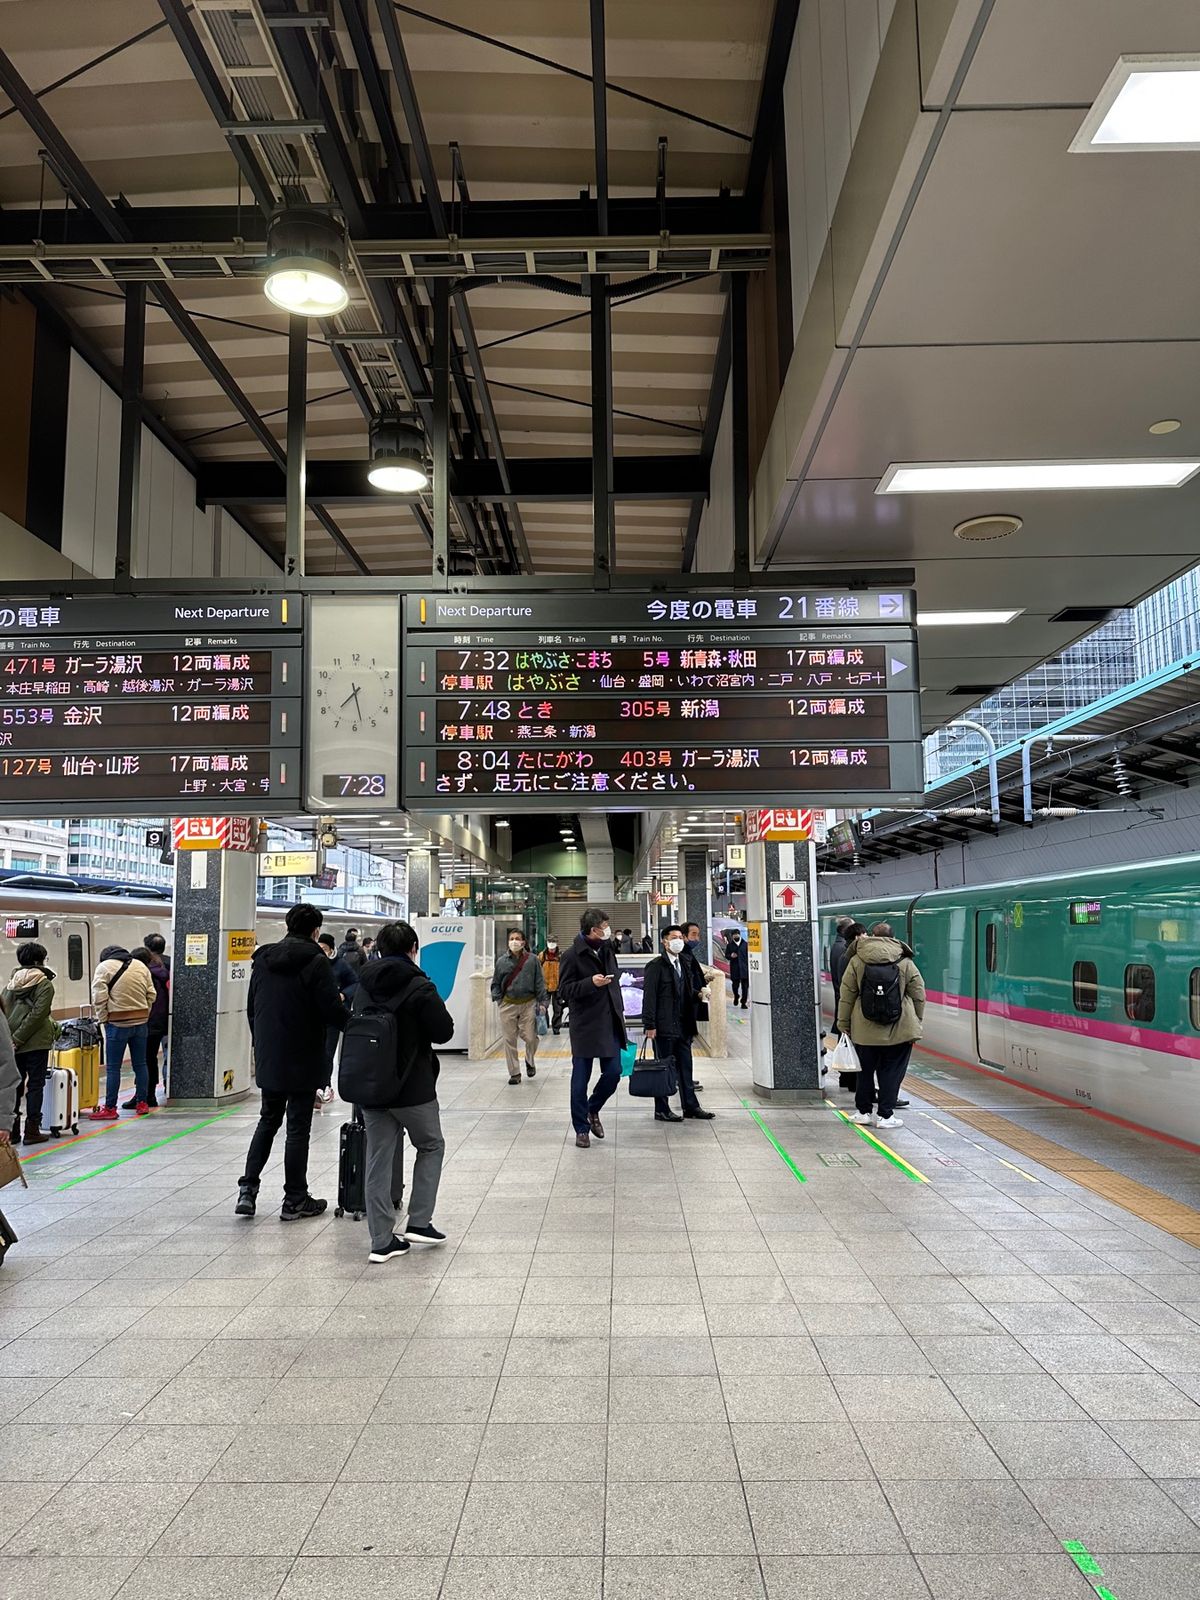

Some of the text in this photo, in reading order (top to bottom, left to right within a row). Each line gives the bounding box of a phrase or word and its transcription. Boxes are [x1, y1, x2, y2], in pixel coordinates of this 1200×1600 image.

[175, 607, 270, 620] Next Departure
[438, 605, 532, 619] Next Departure
[647, 596, 860, 620] 今度の電車 21番線
[0, 606, 61, 628] の電車
[73, 640, 90, 648] 行先
[185, 638, 202, 646] 記事
[453, 635, 471, 644] 時刻
[538, 635, 562, 644] 列車名
[610, 635, 627, 643] 番号
[687, 634, 704, 643] 行先
[710, 634, 750, 642] Destination
[800, 633, 816, 641] 記事
[333, 658, 341, 666] 11
[352, 653, 360, 661] 12
[372, 658, 375, 666] 1
[458, 649, 864, 670] 7:32 はやぶさ・こまち 5号 新青森・秋田 17両編成
[4, 654, 251, 675] 471号 ガーラ湯沢 12両編成
[319, 671, 328, 679] 10
[384, 671, 390, 679] 2
[440, 674, 494, 690] 停車駅
[507, 673, 581, 691] はやぶさ
[316, 689, 322, 697] 9
[388, 689, 394, 697] 3
[3, 704, 250, 725] 553号 金沢 12両編成
[320, 706, 326, 715] 8
[383, 706, 388, 714] 4
[458, 698, 865, 720] 7:48 とき 305号 新潟 12両編成
[334, 720, 339, 728] 7
[352, 724, 357, 732] 6
[371, 720, 376, 728] 5
[440, 724, 494, 741] 停車駅
[457, 748, 868, 770] 8:04 たにがわ 403号 ガーラ湯沢 12両編成
[2, 755, 249, 776] 127号 仙台・山形 17両編成
[339, 775, 385, 796] 7:28
[862, 820, 871, 832] 9
[150, 832, 160, 844] 9
[431, 925, 463, 933] acure
